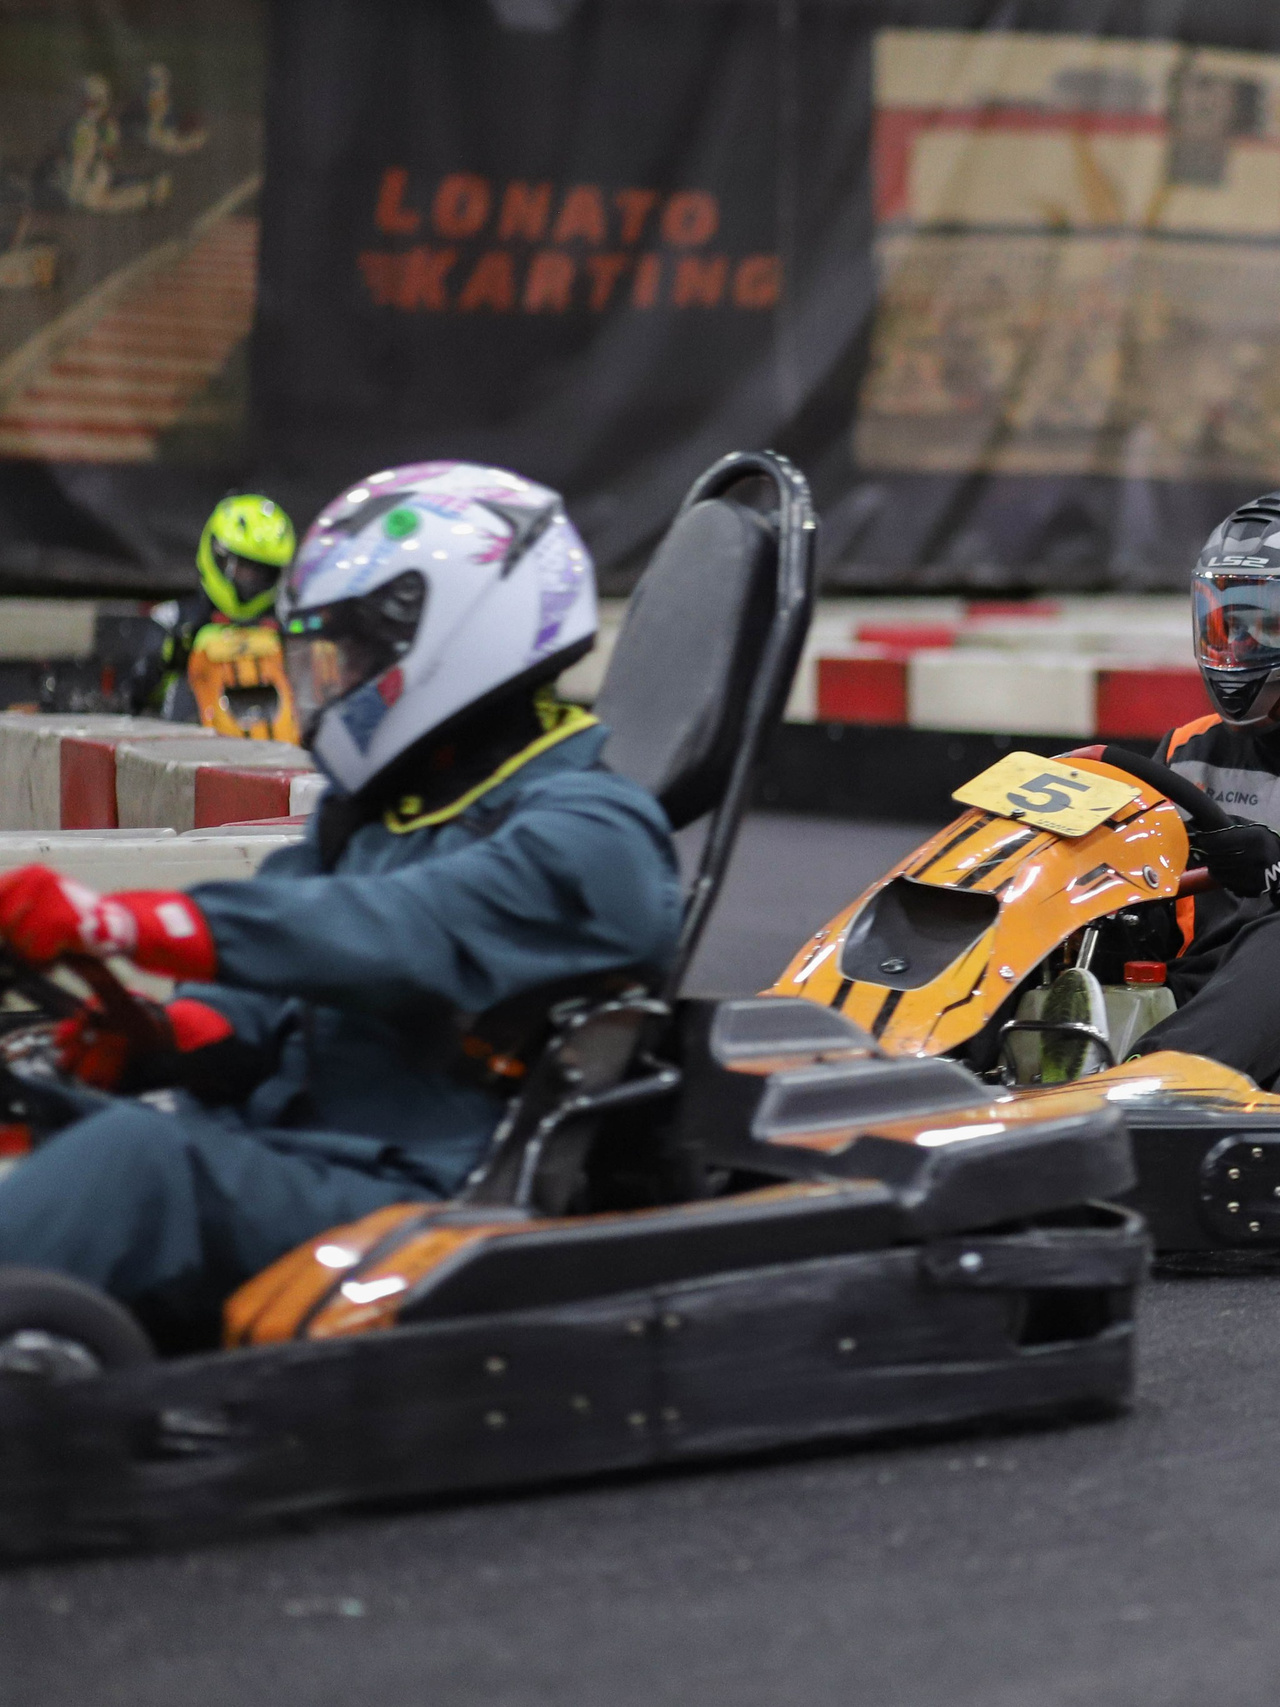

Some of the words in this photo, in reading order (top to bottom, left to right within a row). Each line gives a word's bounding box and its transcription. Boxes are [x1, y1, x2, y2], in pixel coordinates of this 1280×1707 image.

[374, 168, 719, 247] LONATO
[378, 247, 782, 312] KARTING
[1208, 555, 1270, 568] LS2
[1006, 772, 1092, 814] 5
[1207, 787, 1259, 806] RACING
